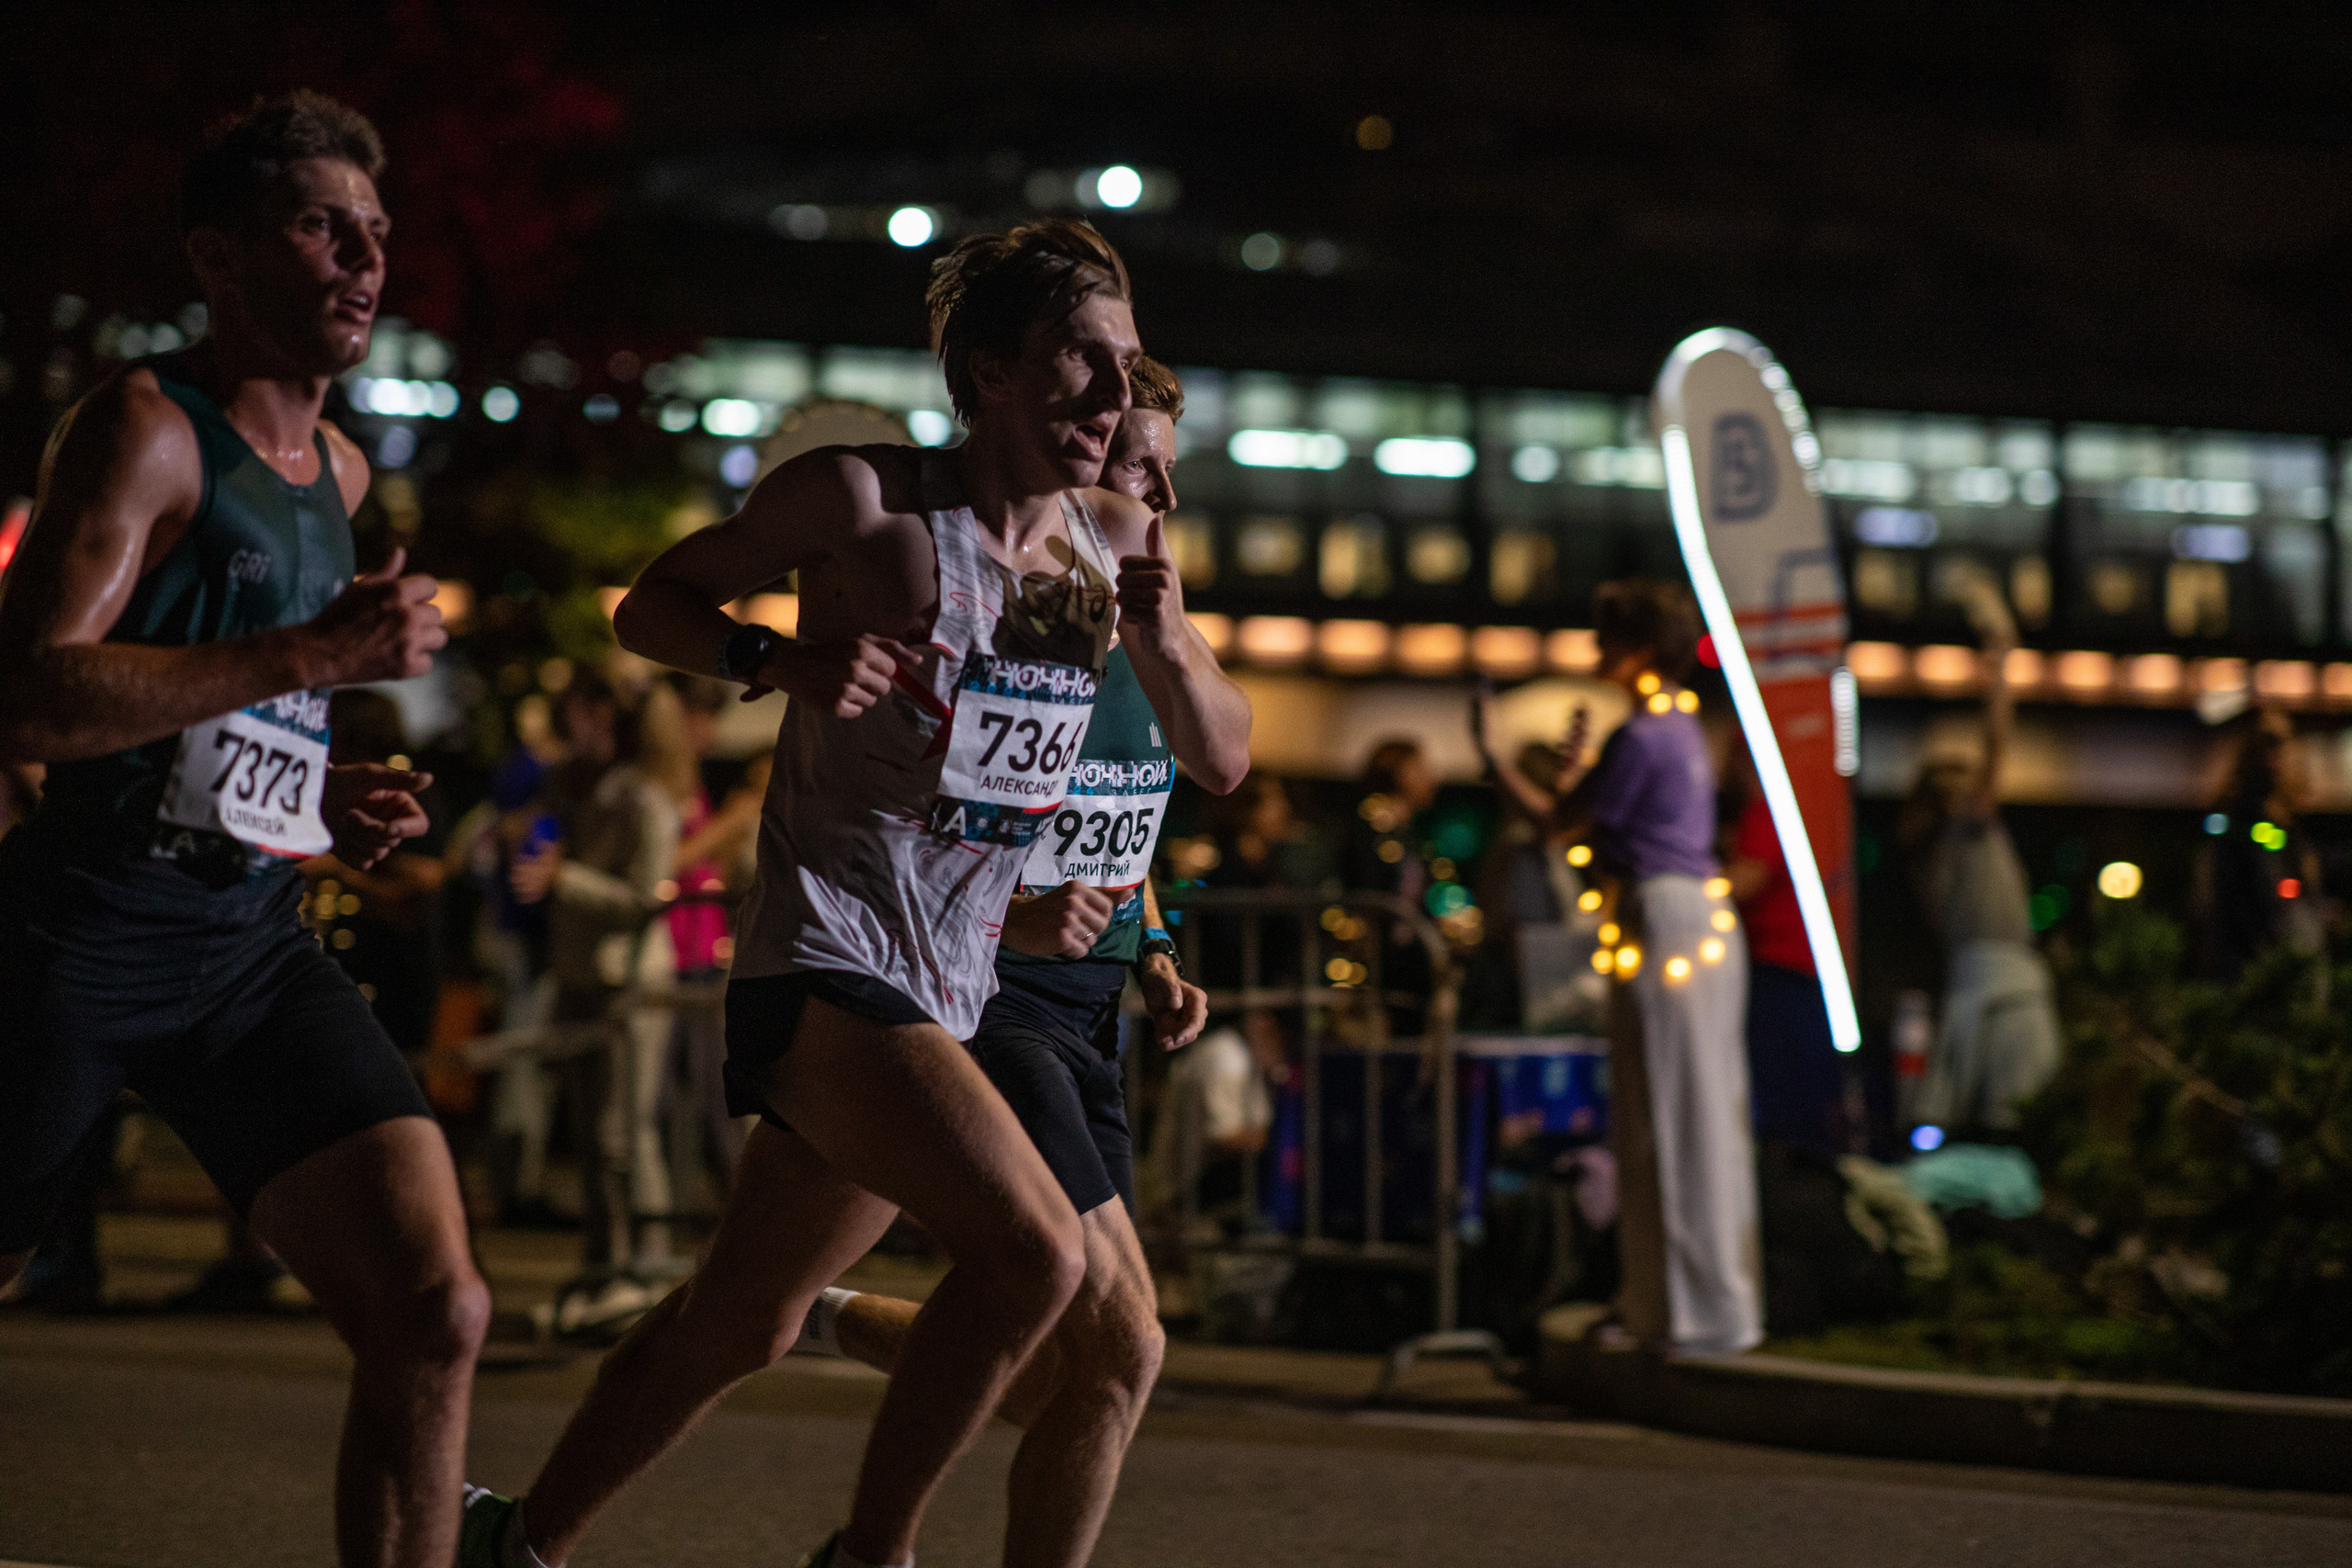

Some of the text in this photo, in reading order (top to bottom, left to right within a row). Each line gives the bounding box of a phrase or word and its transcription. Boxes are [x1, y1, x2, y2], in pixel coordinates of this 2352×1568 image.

[978, 711, 1083, 774] 7366
[211, 728, 308, 816] 7373
[1054, 807, 1154, 857] 9305
[1065, 860, 1130, 877] ДМИТРИЙ
